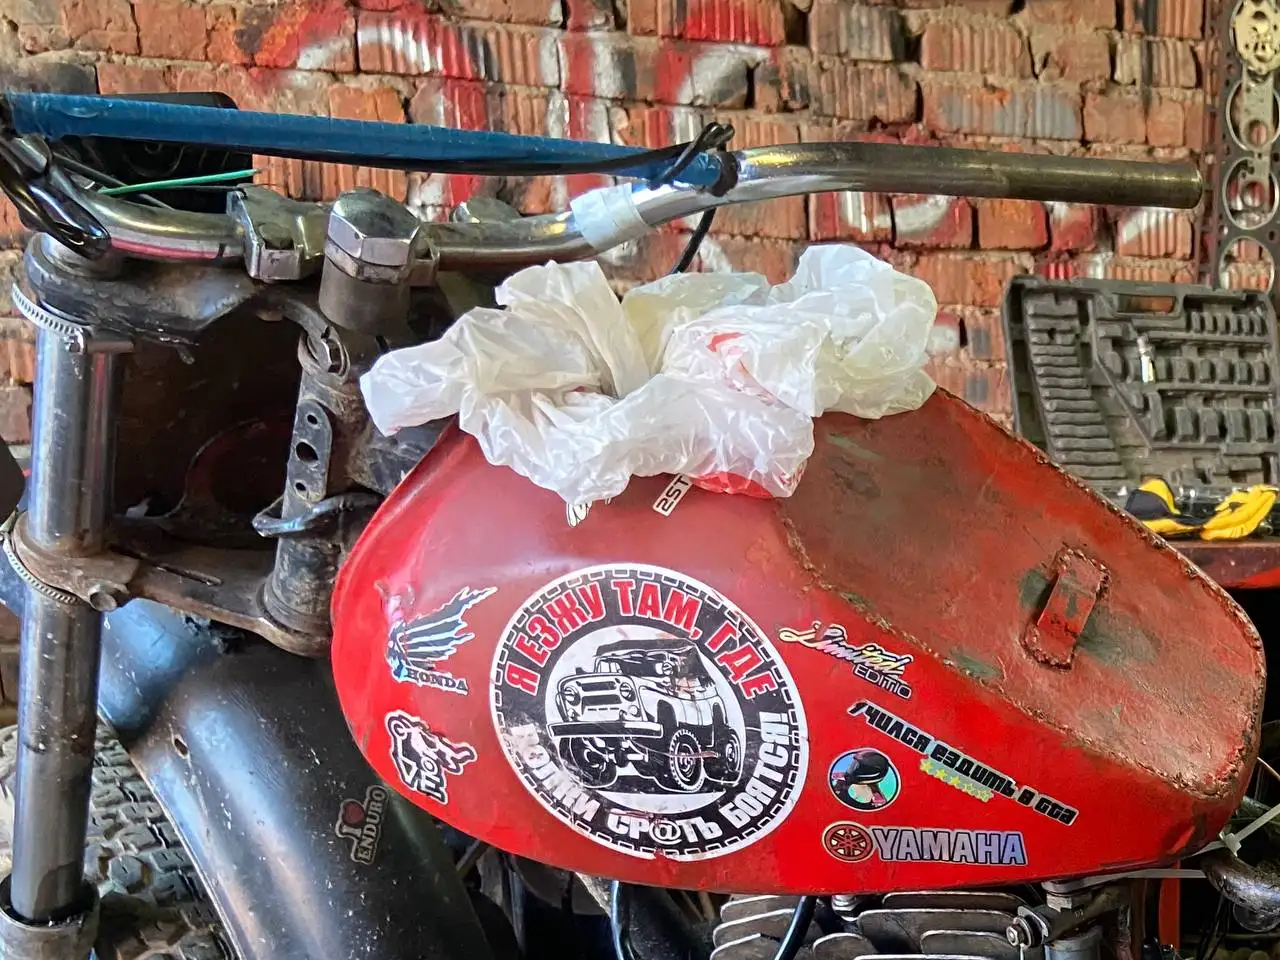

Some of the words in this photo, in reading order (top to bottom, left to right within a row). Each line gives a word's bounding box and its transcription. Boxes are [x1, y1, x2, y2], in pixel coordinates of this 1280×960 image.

[513, 582, 607, 668] ЕЗЖУ
[611, 579, 704, 641] ТАМ,
[405, 667, 469, 693] HONDA
[505, 661, 541, 696] Я
[705, 619, 777, 700] ГДЕ
[718, 710, 791, 830] БОЯТСЯ!
[357, 788, 388, 864] ENDURO
[872, 827, 1027, 865] YAMAHA
